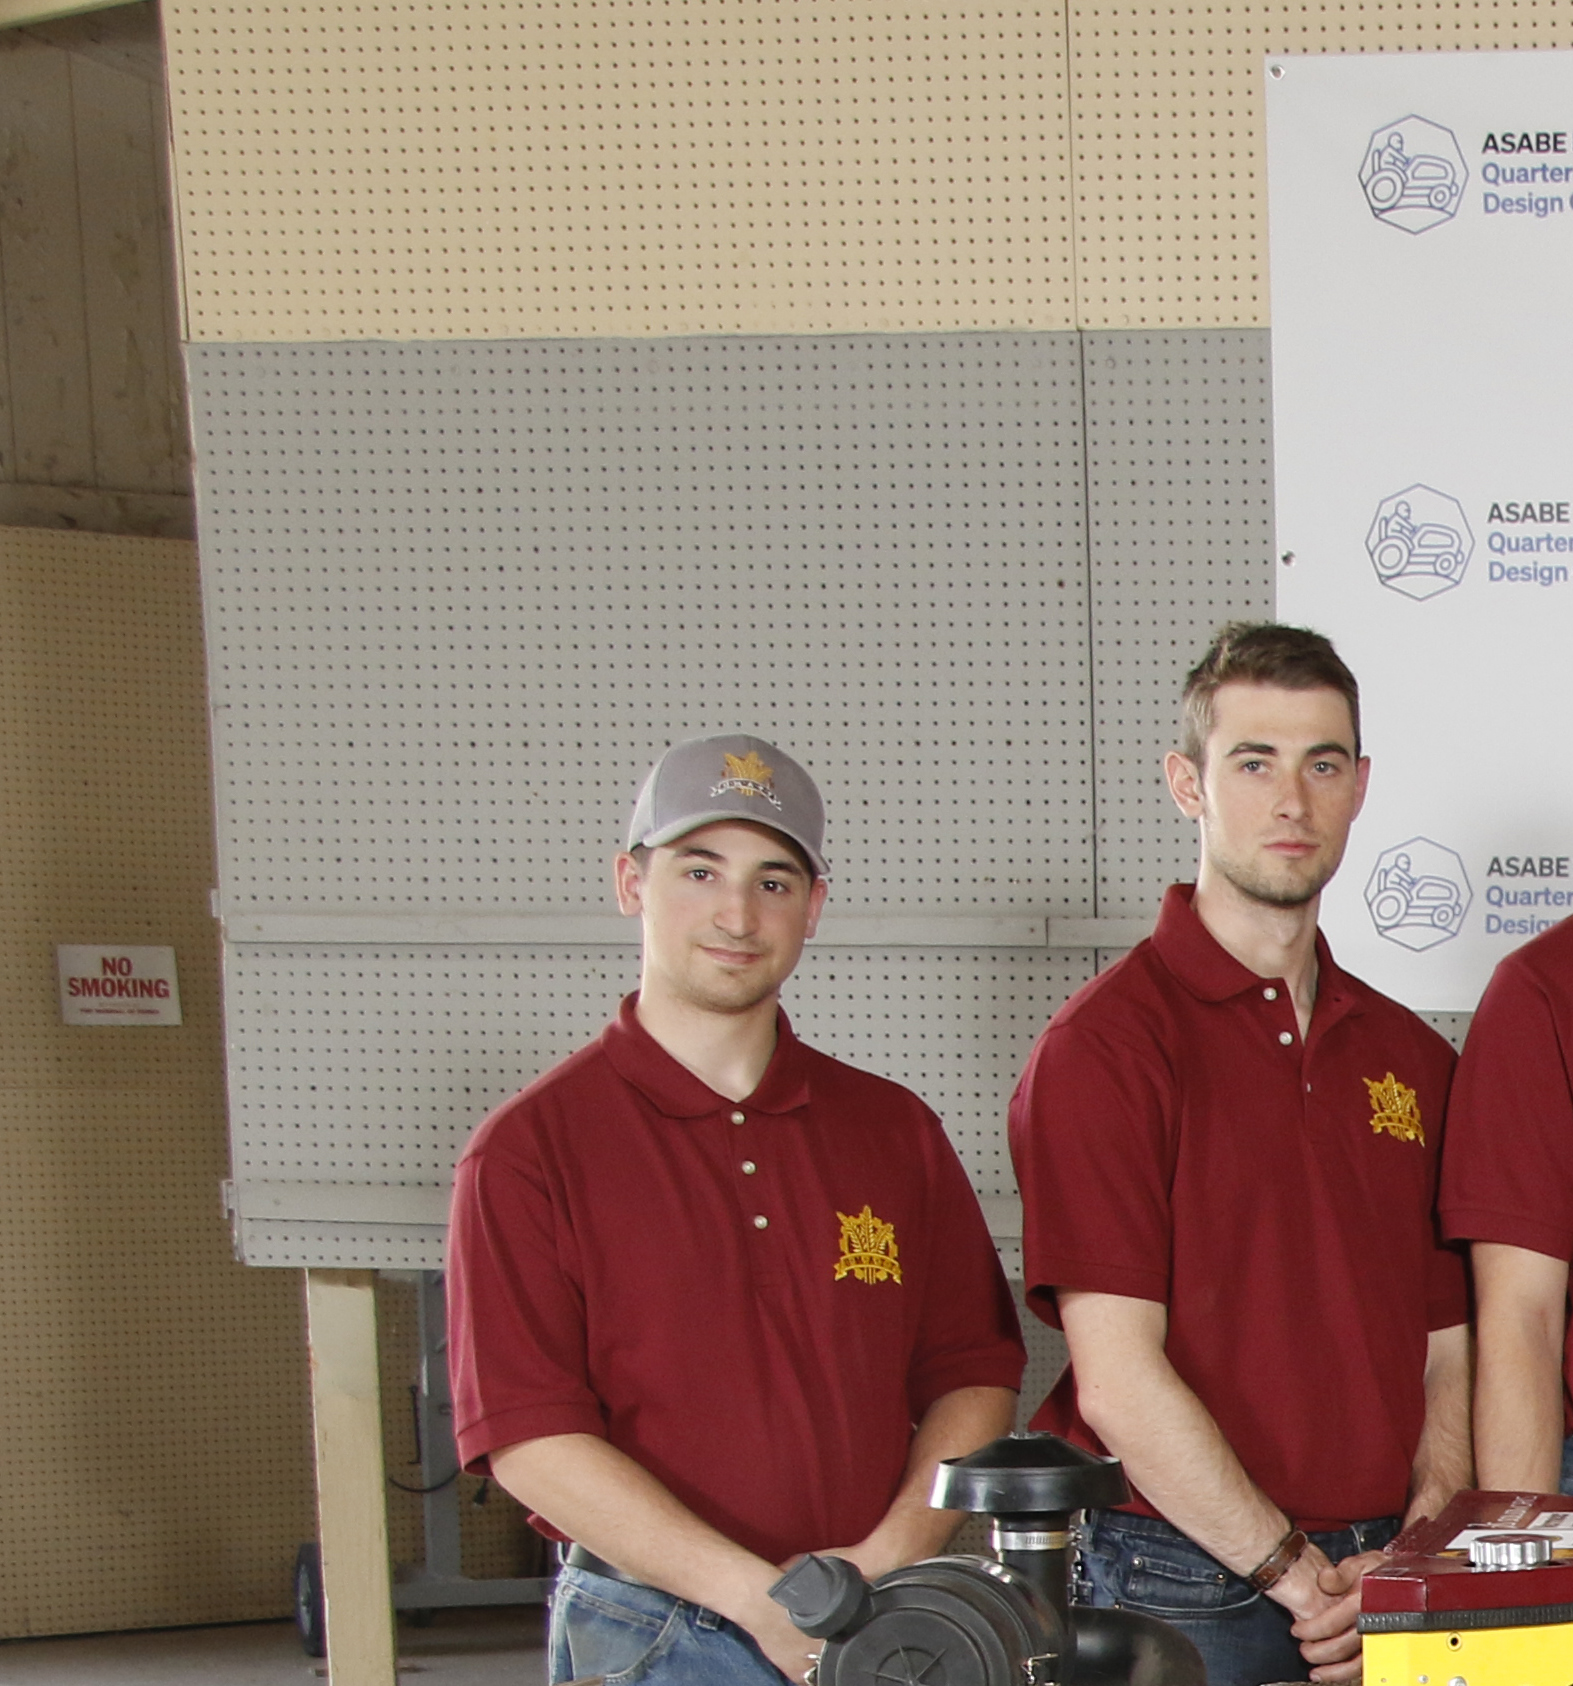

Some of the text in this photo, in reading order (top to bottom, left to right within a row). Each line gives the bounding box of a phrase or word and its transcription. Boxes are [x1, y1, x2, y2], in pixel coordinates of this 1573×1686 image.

[1481, 131, 1567, 154] ASABE
[1481, 162, 1573, 187] Quarter
[1483, 192, 1564, 218] Design
[1487, 502, 1570, 524] ASABE
[1489, 561, 1568, 587] Design
[1487, 857, 1569, 878] ASABE
[101, 957, 133, 977] NO
[68, 977, 170, 998] SMOKING
